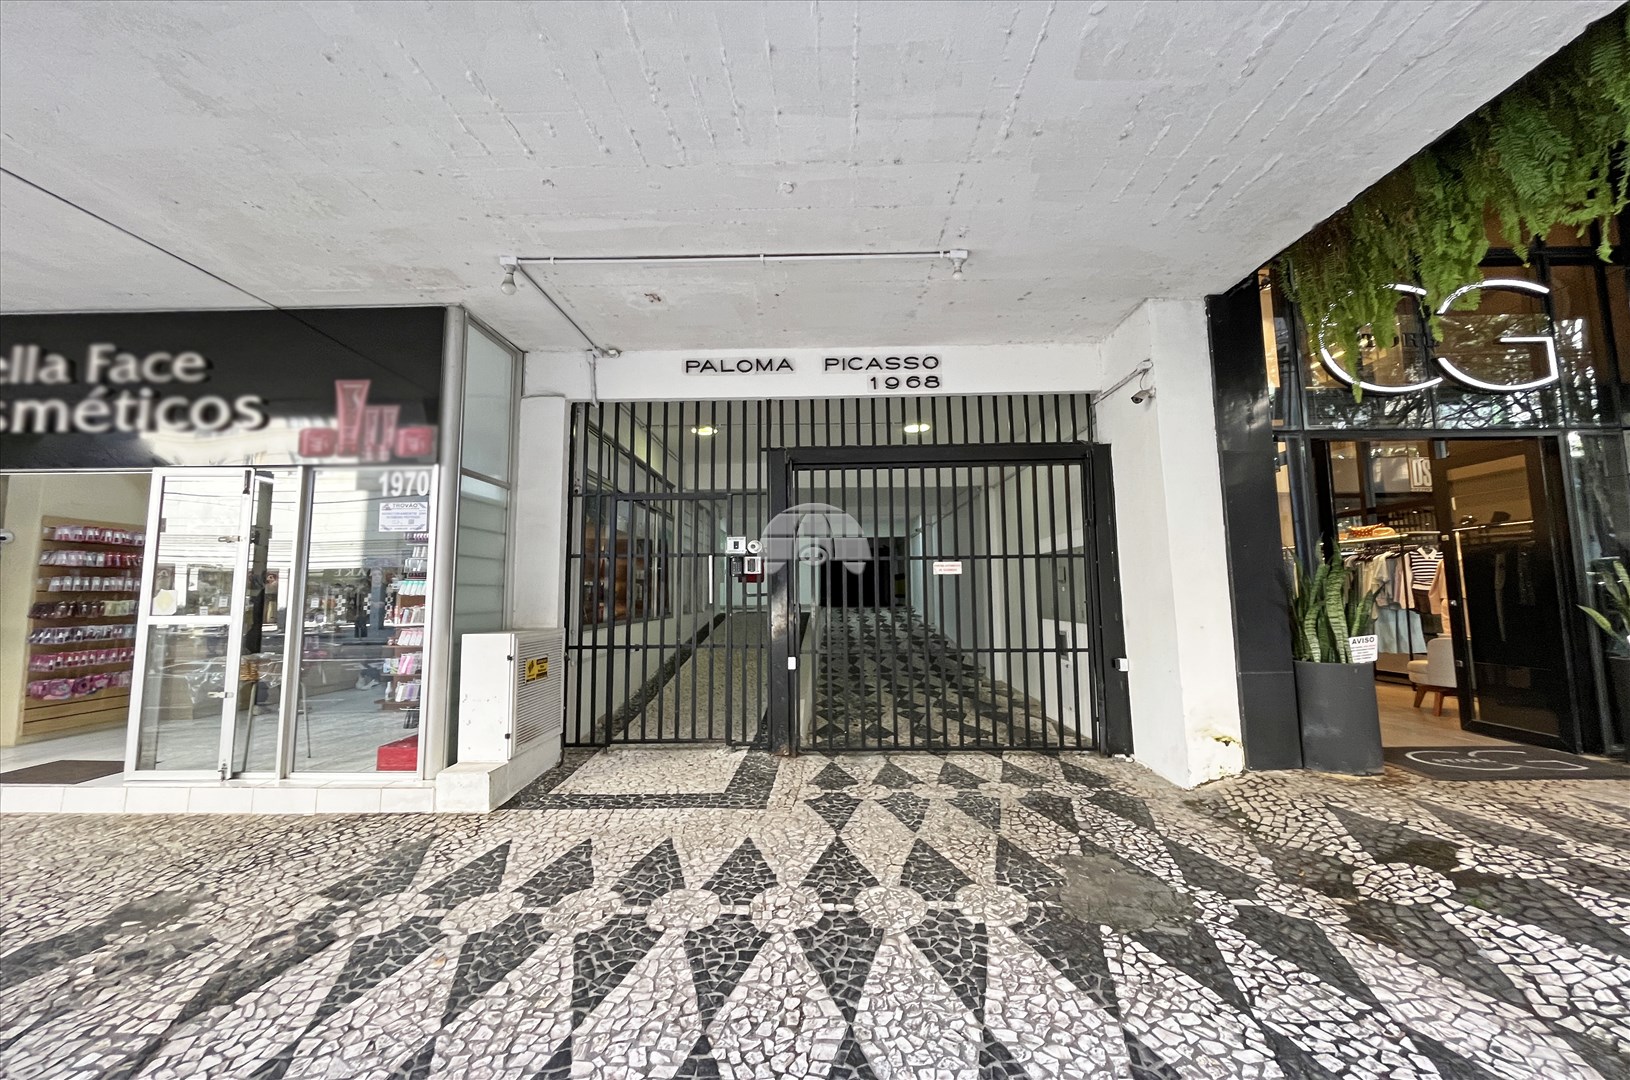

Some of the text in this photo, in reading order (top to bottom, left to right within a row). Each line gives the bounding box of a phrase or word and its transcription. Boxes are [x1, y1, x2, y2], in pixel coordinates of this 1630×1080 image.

[0, 343, 208, 384] lla Face
[685, 356, 939, 373] PALOMA PICASSO
[870, 376, 940, 390] 1968
[0, 385, 265, 434] méticos
[379, 470, 430, 497] 1970
[1351, 636, 1375, 645] AVISO
